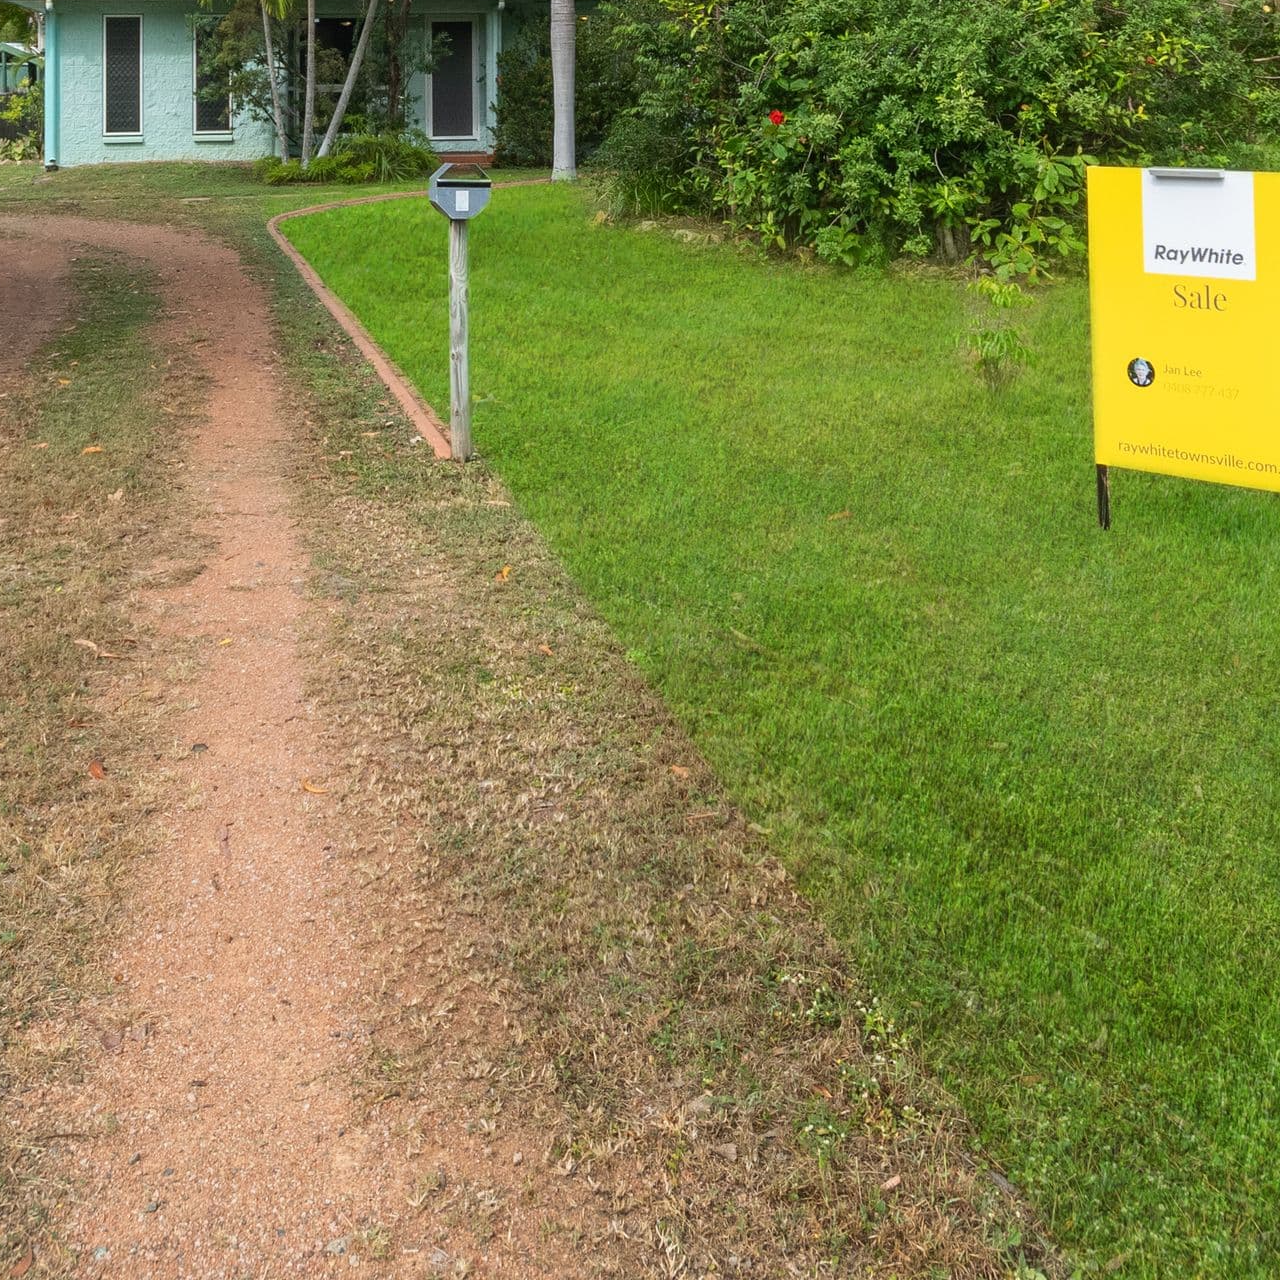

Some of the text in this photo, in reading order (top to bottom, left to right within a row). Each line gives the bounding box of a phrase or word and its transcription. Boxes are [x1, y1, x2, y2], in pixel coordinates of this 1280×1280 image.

[1173, 283, 1227, 312] Sale
[1163, 363, 1202, 377] Jan Lee
